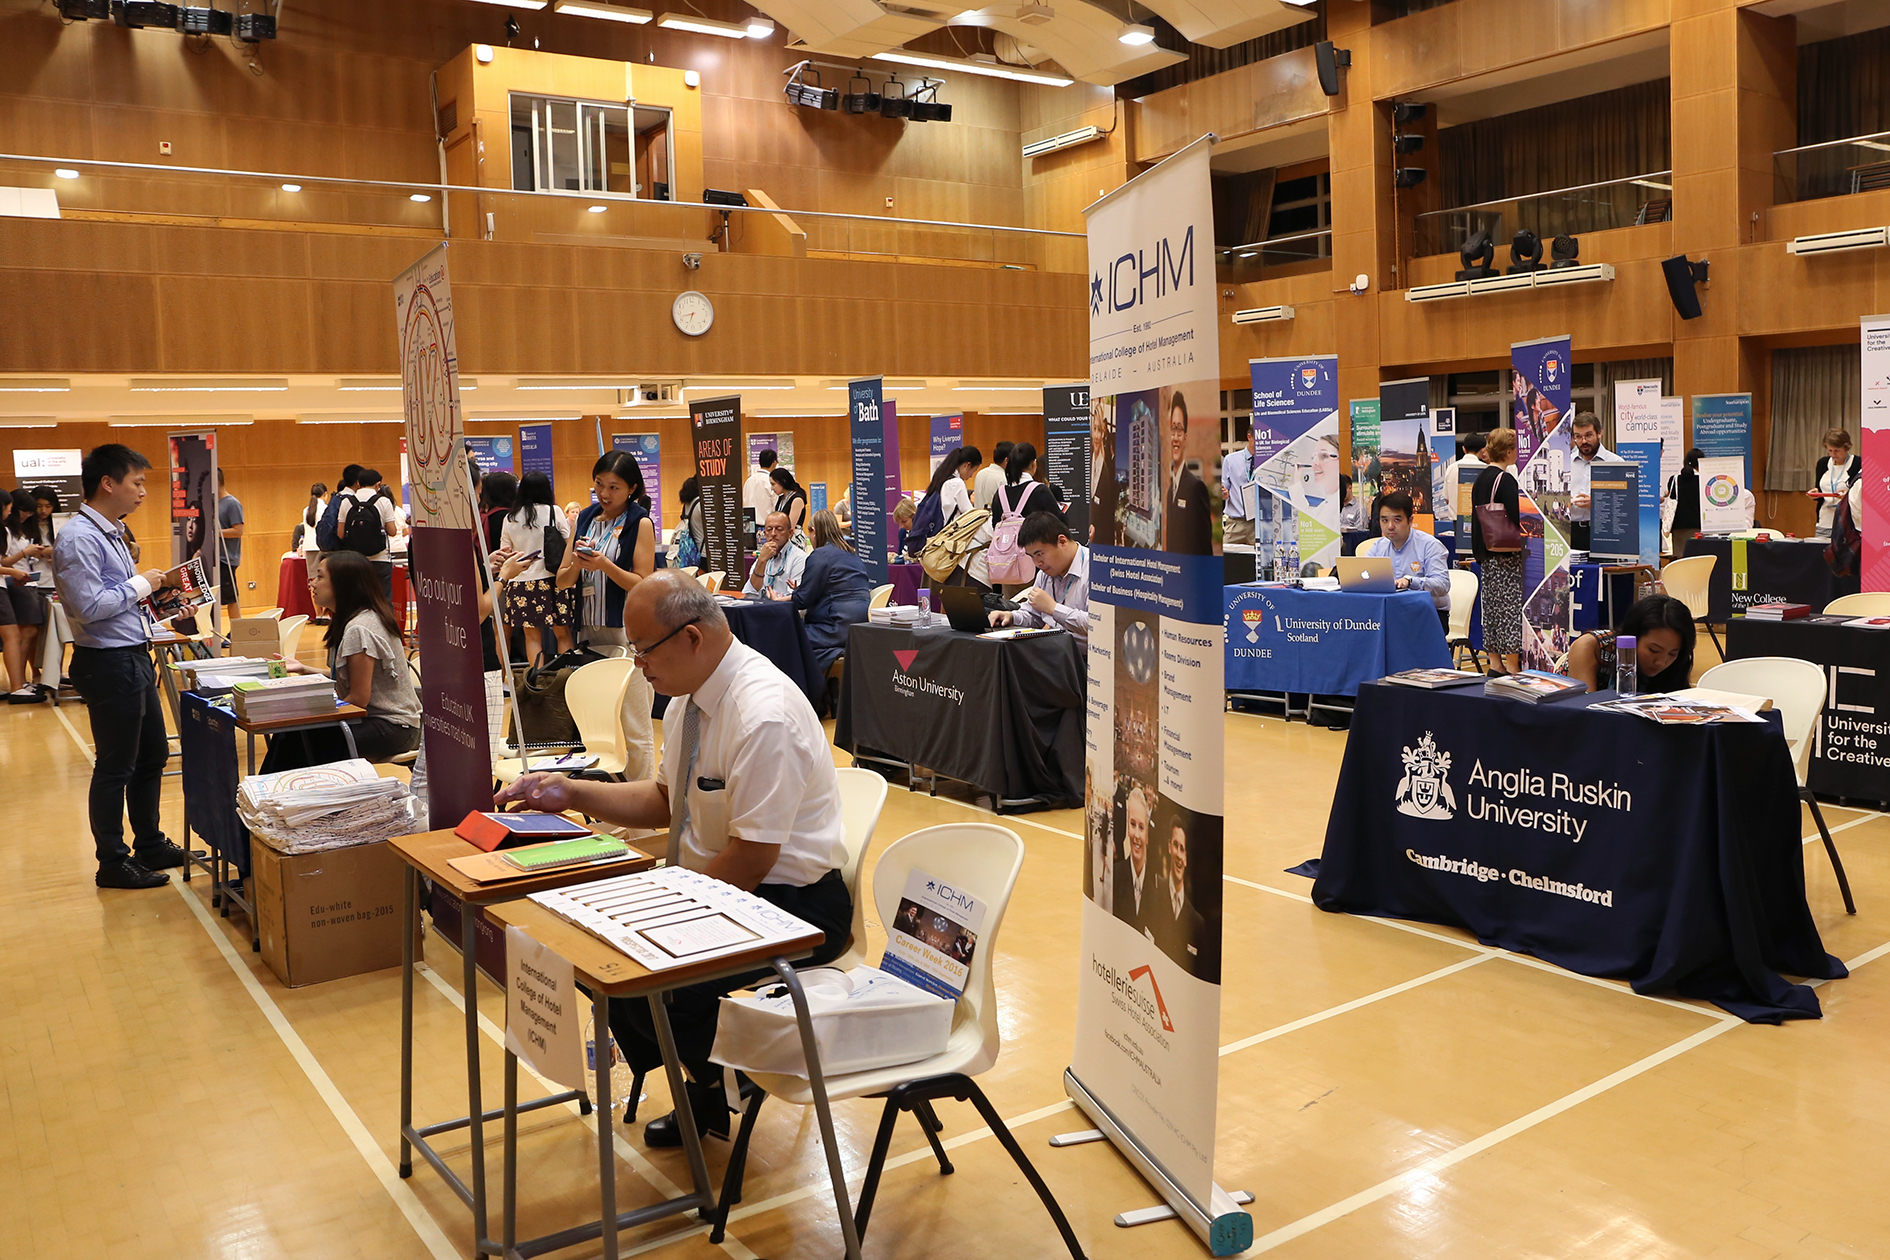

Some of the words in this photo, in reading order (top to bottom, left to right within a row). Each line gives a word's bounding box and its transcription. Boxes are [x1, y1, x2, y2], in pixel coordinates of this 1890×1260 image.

[1108, 225, 1193, 314] ICHM
[1133, 324, 1142, 333] Est.
[1090, 349, 1114, 364] nternational
[1114, 346, 1136, 359] College
[1138, 342, 1145, 353] of
[1146, 340, 1158, 352] Hotel
[1158, 328, 1194, 348] Management
[1090, 367, 1122, 384] DELAIDE
[1148, 352, 1194, 372] AUSTRALIA
[1294, 360, 1318, 372] UNIVERSITY
[853, 388, 873, 400] University
[1254, 391, 1275, 400] School
[1266, 399, 1294, 407] Sciences
[705, 410, 730, 418] UNIVERSITY
[706, 416, 734, 424] BIRMINGHAM
[858, 399, 879, 422] Bath
[1620, 411, 1634, 423] city
[1254, 429, 1272, 440] No1
[1626, 422, 1658, 433] campus
[699, 439, 721, 458] AREAS
[723, 438, 732, 456] OF
[933, 444, 946, 452] Hope?
[942, 434, 961, 443] Liverpool
[1518, 434, 1530, 448] No1
[700, 458, 726, 477] STUDY
[1551, 543, 1563, 556] 205
[1093, 553, 1109, 562] Bachelor
[1115, 556, 1146, 567] International
[1147, 560, 1157, 569] Hotel
[180, 567, 193, 592] GREAT
[193, 560, 212, 602] KNOWLEDGE
[1110, 568, 1125, 578] (Swiss
[1126, 570, 1139, 580] Hotel
[1140, 572, 1164, 587] Association)
[416, 571, 433, 604] Map
[434, 576, 446, 602] out
[446, 582, 463, 609] your
[1091, 582, 1106, 593] Bachelor
[1106, 585, 1112, 593] of
[1112, 586, 1133, 597] Business
[1134, 588, 1158, 604] (Hospitality
[1732, 593, 1752, 602] New
[1753, 593, 1787, 604] College
[1228, 591, 1266, 610] UNIVERSITY
[1265, 600, 1275, 610] OF
[444, 616, 467, 649] future
[1285, 617, 1330, 633] University
[1333, 618, 1343, 629] of
[1344, 619, 1381, 631] Dundee
[1178, 633, 1213, 647] Resources
[1287, 633, 1319, 643] Scotland
[1177, 654, 1201, 668] Division
[1233, 648, 1272, 658] DUNDEE
[892, 669, 918, 689] Aston
[919, 677, 965, 705] University
[894, 684, 914, 697] Birmingham
[1164, 684, 1192, 702] Management
[441, 692, 464, 718] Education
[464, 705, 474, 723] UK
[462, 728, 476, 750] show
[1164, 726, 1181, 742] Financial
[1828, 731, 1850, 746] for
[1854, 735, 1877, 749] the
[1164, 740, 1192, 760] Management
[1827, 747, 1890, 767] Creative
[1468, 758, 1545, 798] Anglia
[1551, 772, 1632, 812] Ruskin
[1467, 794, 1588, 843] University
[1406, 848, 1499, 882] Cambridge
[1508, 869, 1612, 907] Chelmsford
[937, 884, 974, 912] ICHM
[310, 901, 352, 915] Edu-white
[311, 913, 355, 929] non-woven
[356, 905, 394, 921] bag-2015
[758, 909, 804, 932] ICHM
[896, 935, 922, 953] Career
[923, 948, 942, 966] Week
[944, 959, 963, 977] 2016
[520, 959, 557, 992] International
[1092, 953, 1155, 1020] hotelleriesuisse
[516, 977, 537, 1002] College
[537, 993, 544, 1006] of
[545, 995, 562, 1016] Hotel
[520, 1000, 557, 1035] Management
[1111, 992, 1126, 1011] Swiss
[1127, 1004, 1141, 1024] Hotel
[1141, 1017, 1170, 1052] Association
[527, 1028, 547, 1054] (ICHM)
